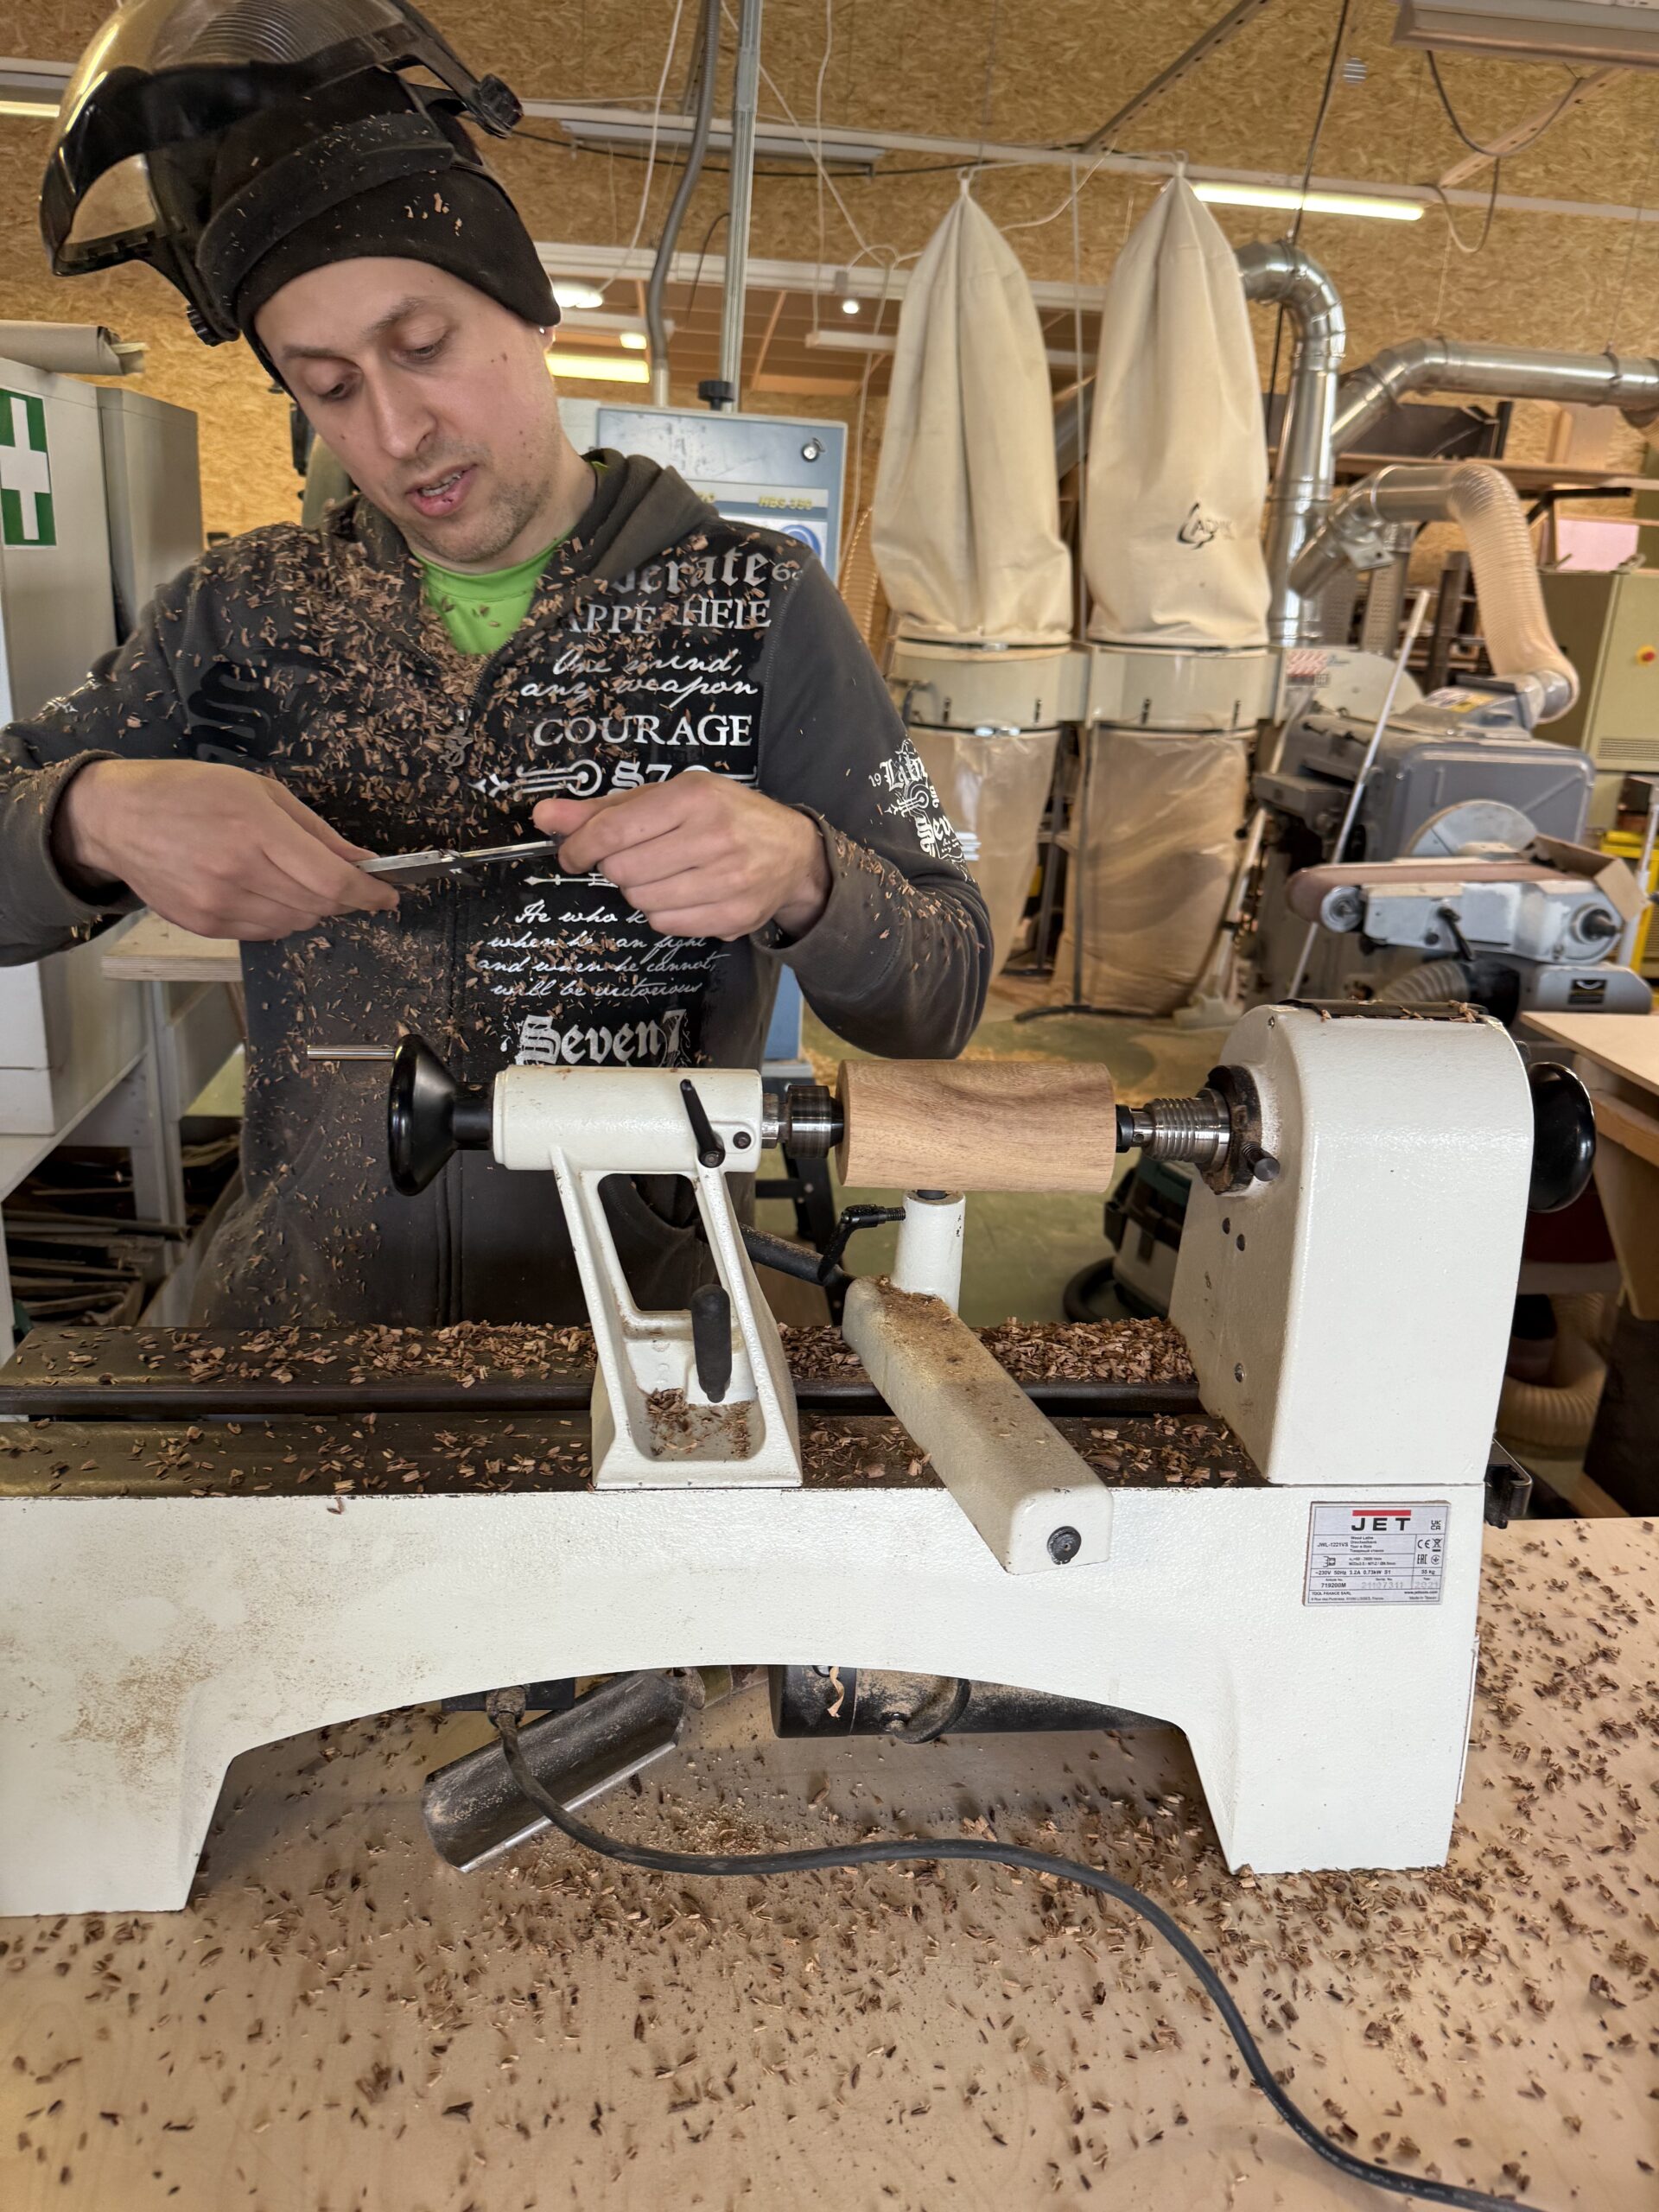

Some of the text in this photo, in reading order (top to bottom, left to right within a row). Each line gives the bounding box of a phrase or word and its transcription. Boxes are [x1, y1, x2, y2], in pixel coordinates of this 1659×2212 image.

[553, 645, 612, 675] One
[612, 676, 758, 711] weapon
[533, 715, 753, 747] COURAGE
[515, 898, 551, 924] He
[558, 906, 619, 924] who
[487, 931, 560, 949] when
[567, 930, 594, 949] he
[610, 938, 647, 949] an
[476, 956, 531, 973] and
[612, 955, 640, 972] he
[490, 976, 557, 996] will
[559, 979, 588, 996] be
[1351, 1517, 1411, 1531] JET
